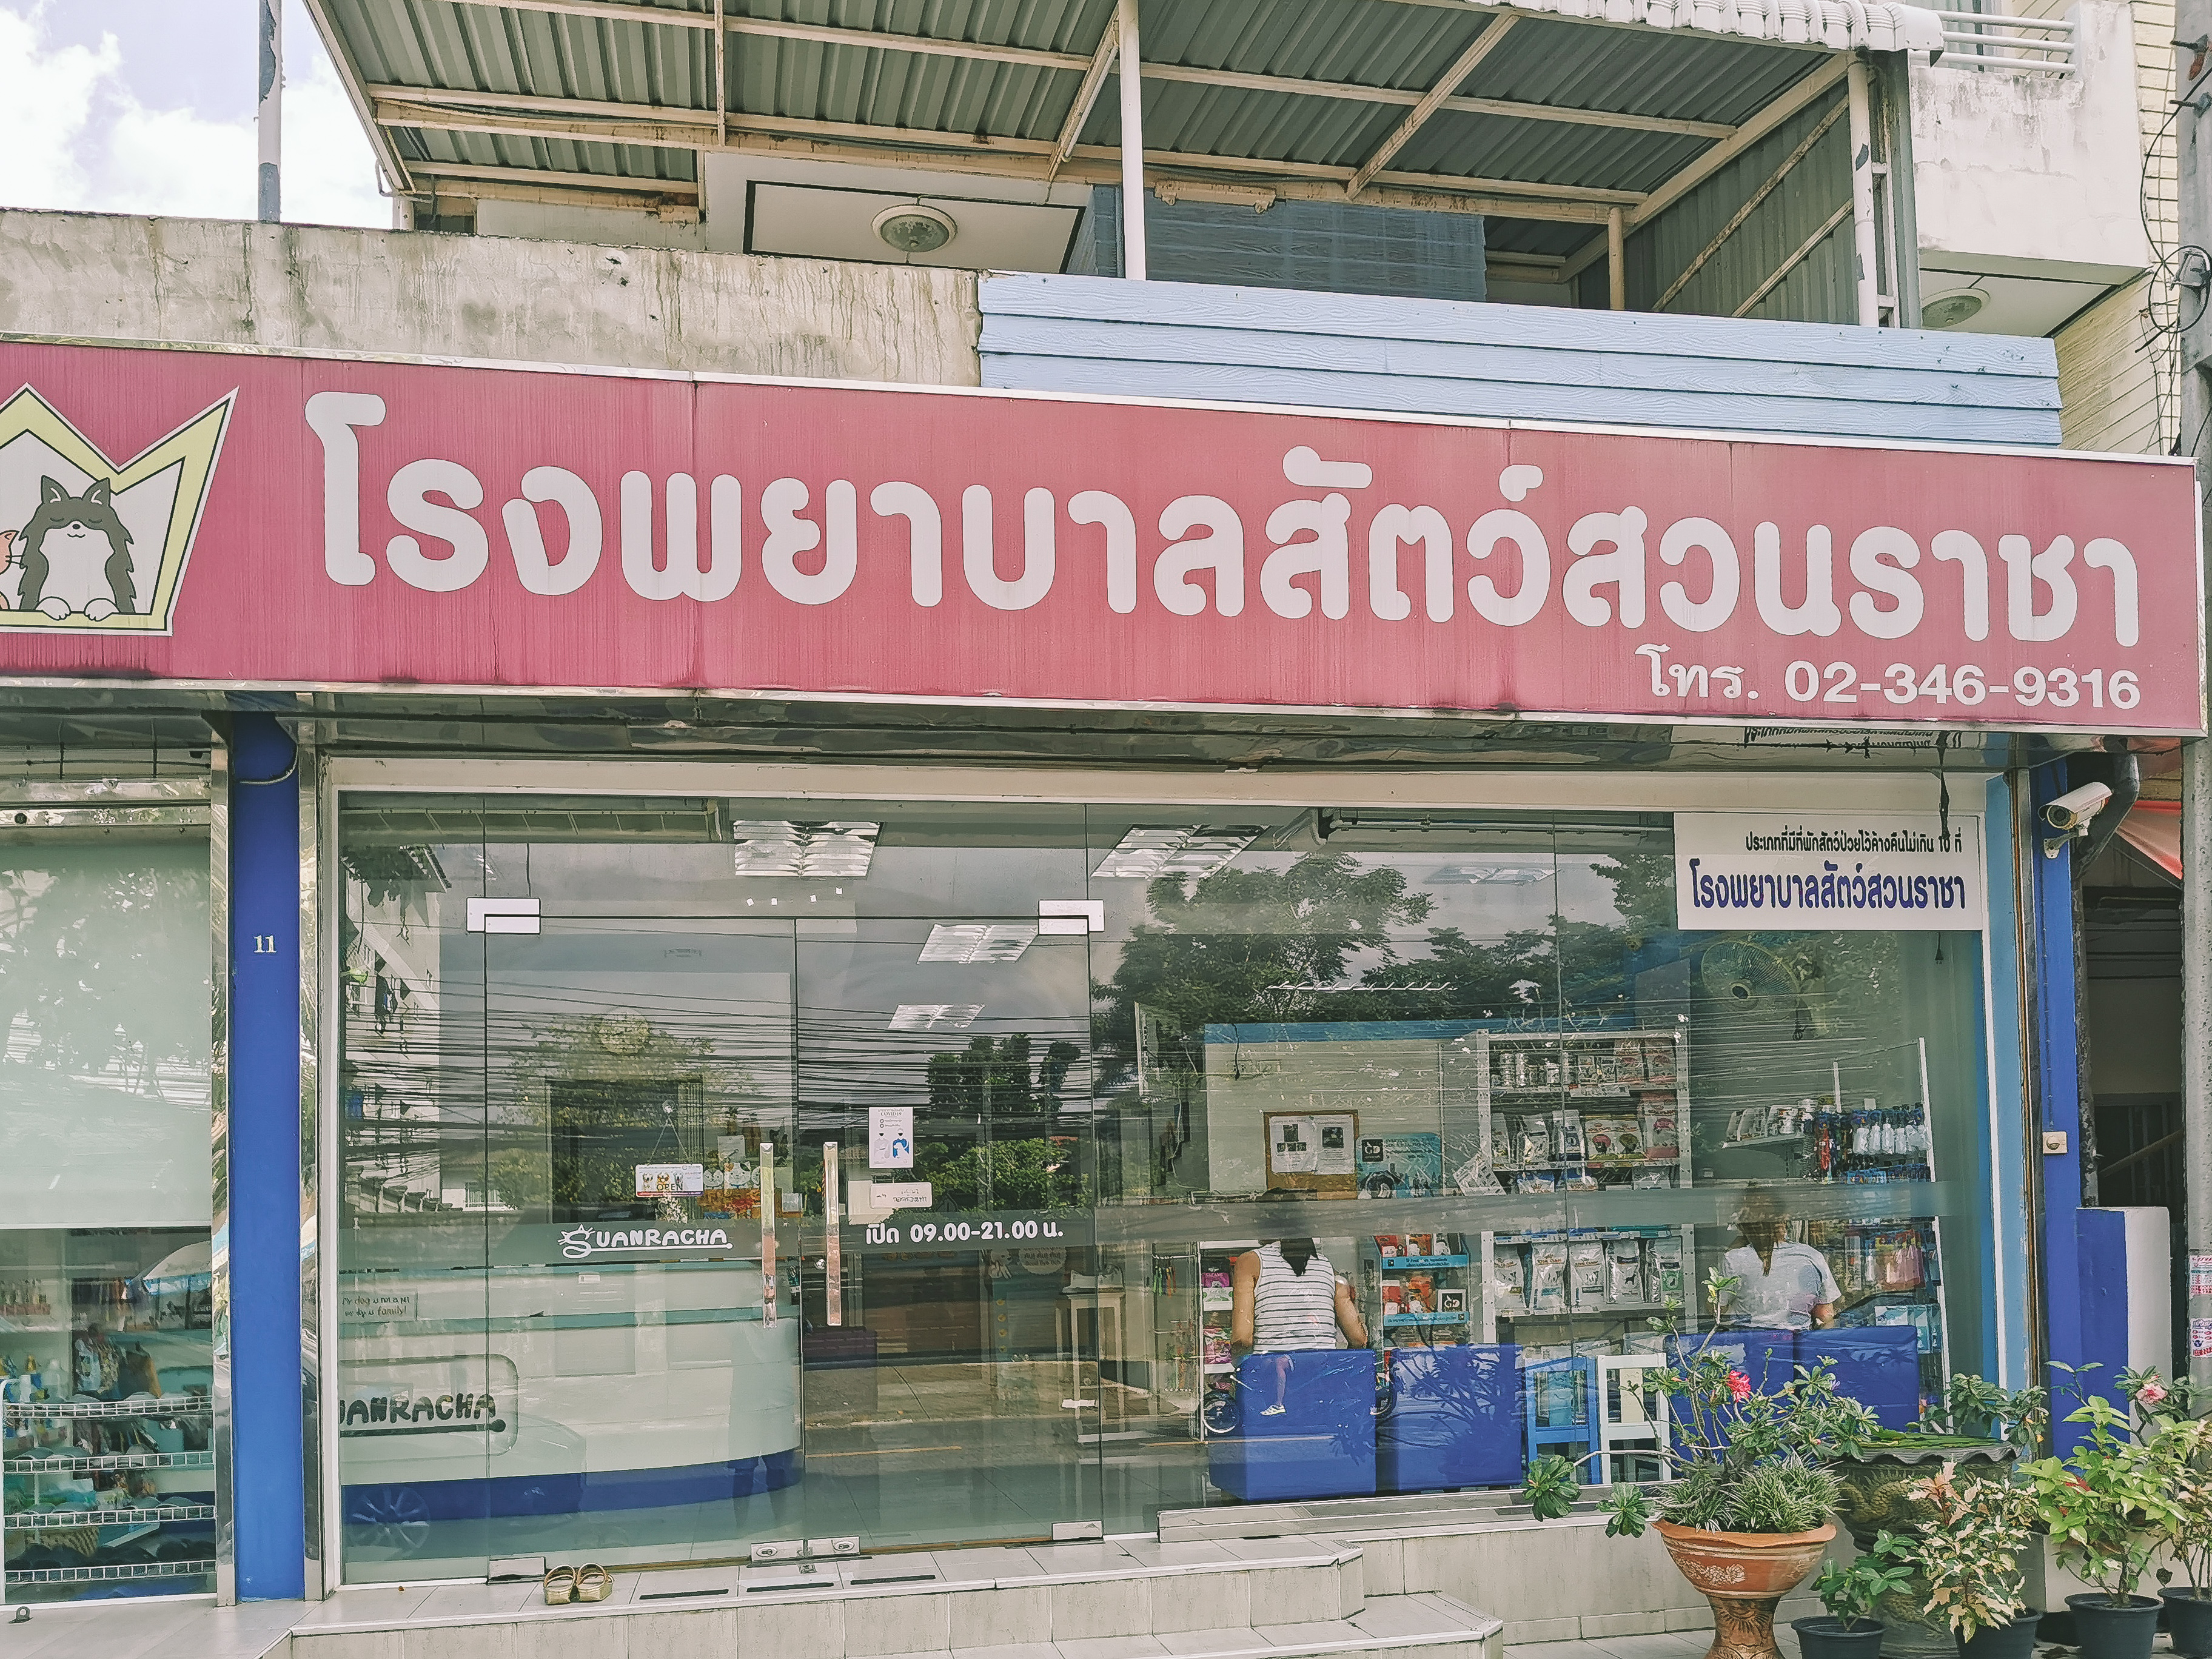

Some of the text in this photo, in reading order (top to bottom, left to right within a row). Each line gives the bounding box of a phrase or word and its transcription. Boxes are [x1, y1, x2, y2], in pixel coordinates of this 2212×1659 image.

[304, 391, 2140, 648] โรงพยาบาลสัตว์สวนราชา
[1635, 643, 2141, 710] โทร. 02-346-9316
[1954, 826, 1963, 854] ที่
[1689, 857, 1966, 910] โรงพยาบาลสัตว์สวนราชา
[253, 934, 277, 953] 11
[557, 1224, 733, 1259] SUANRACHA
[866, 1220, 1064, 1244] เปิด 09.00-21.00 น.
